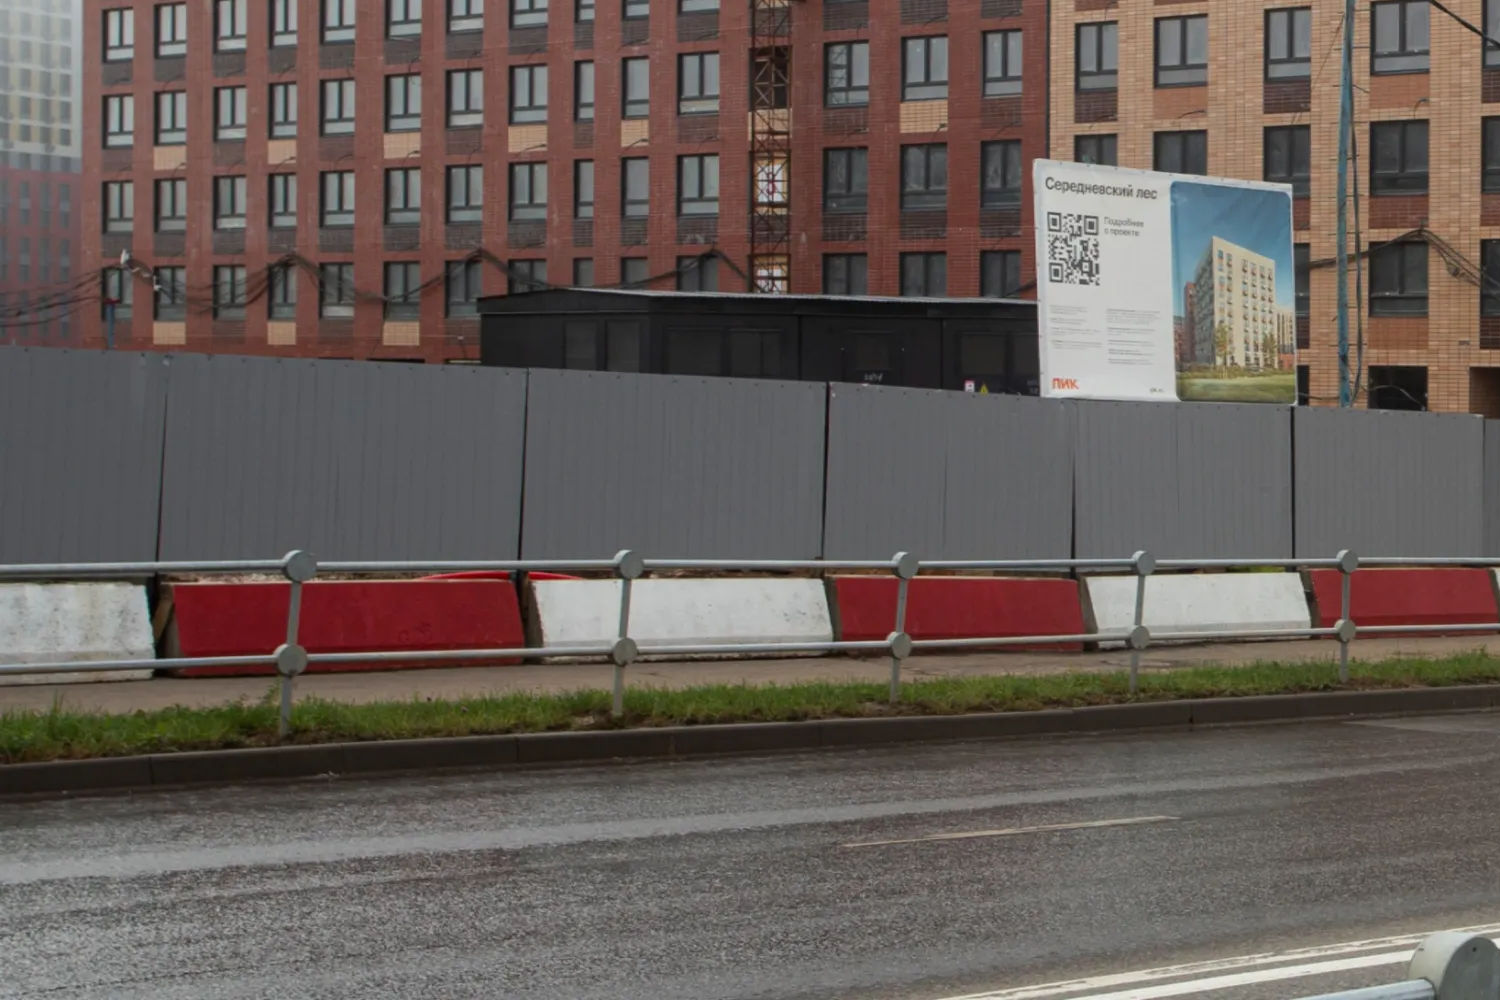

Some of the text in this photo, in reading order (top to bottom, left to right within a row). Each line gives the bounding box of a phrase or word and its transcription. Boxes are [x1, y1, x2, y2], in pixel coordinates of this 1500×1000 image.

[1045, 176, 1158, 200] Середневский лес
[1052, 377, 1080, 390] ПИК
